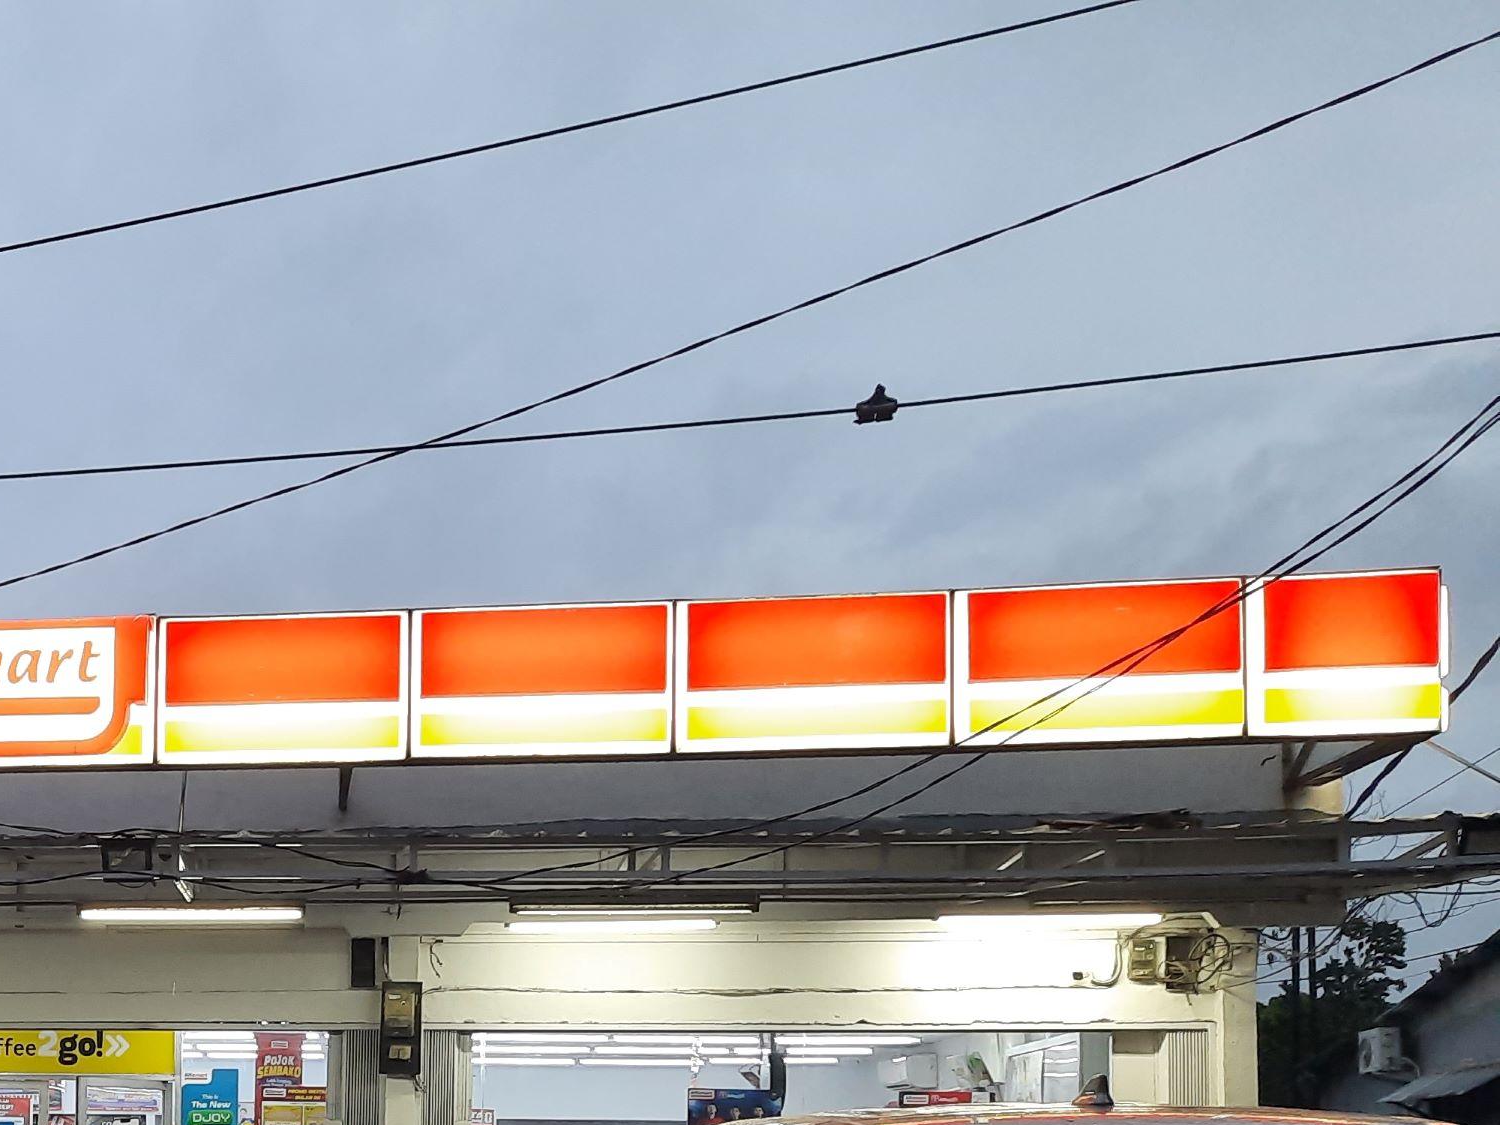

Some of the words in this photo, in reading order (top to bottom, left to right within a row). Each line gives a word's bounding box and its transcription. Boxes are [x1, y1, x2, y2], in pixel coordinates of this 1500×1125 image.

[264, 1055, 295, 1066] POJOK
[191, 1101, 207, 1109] The
[209, 1101, 231, 1109] New
[192, 1113, 230, 1123] DJOY
